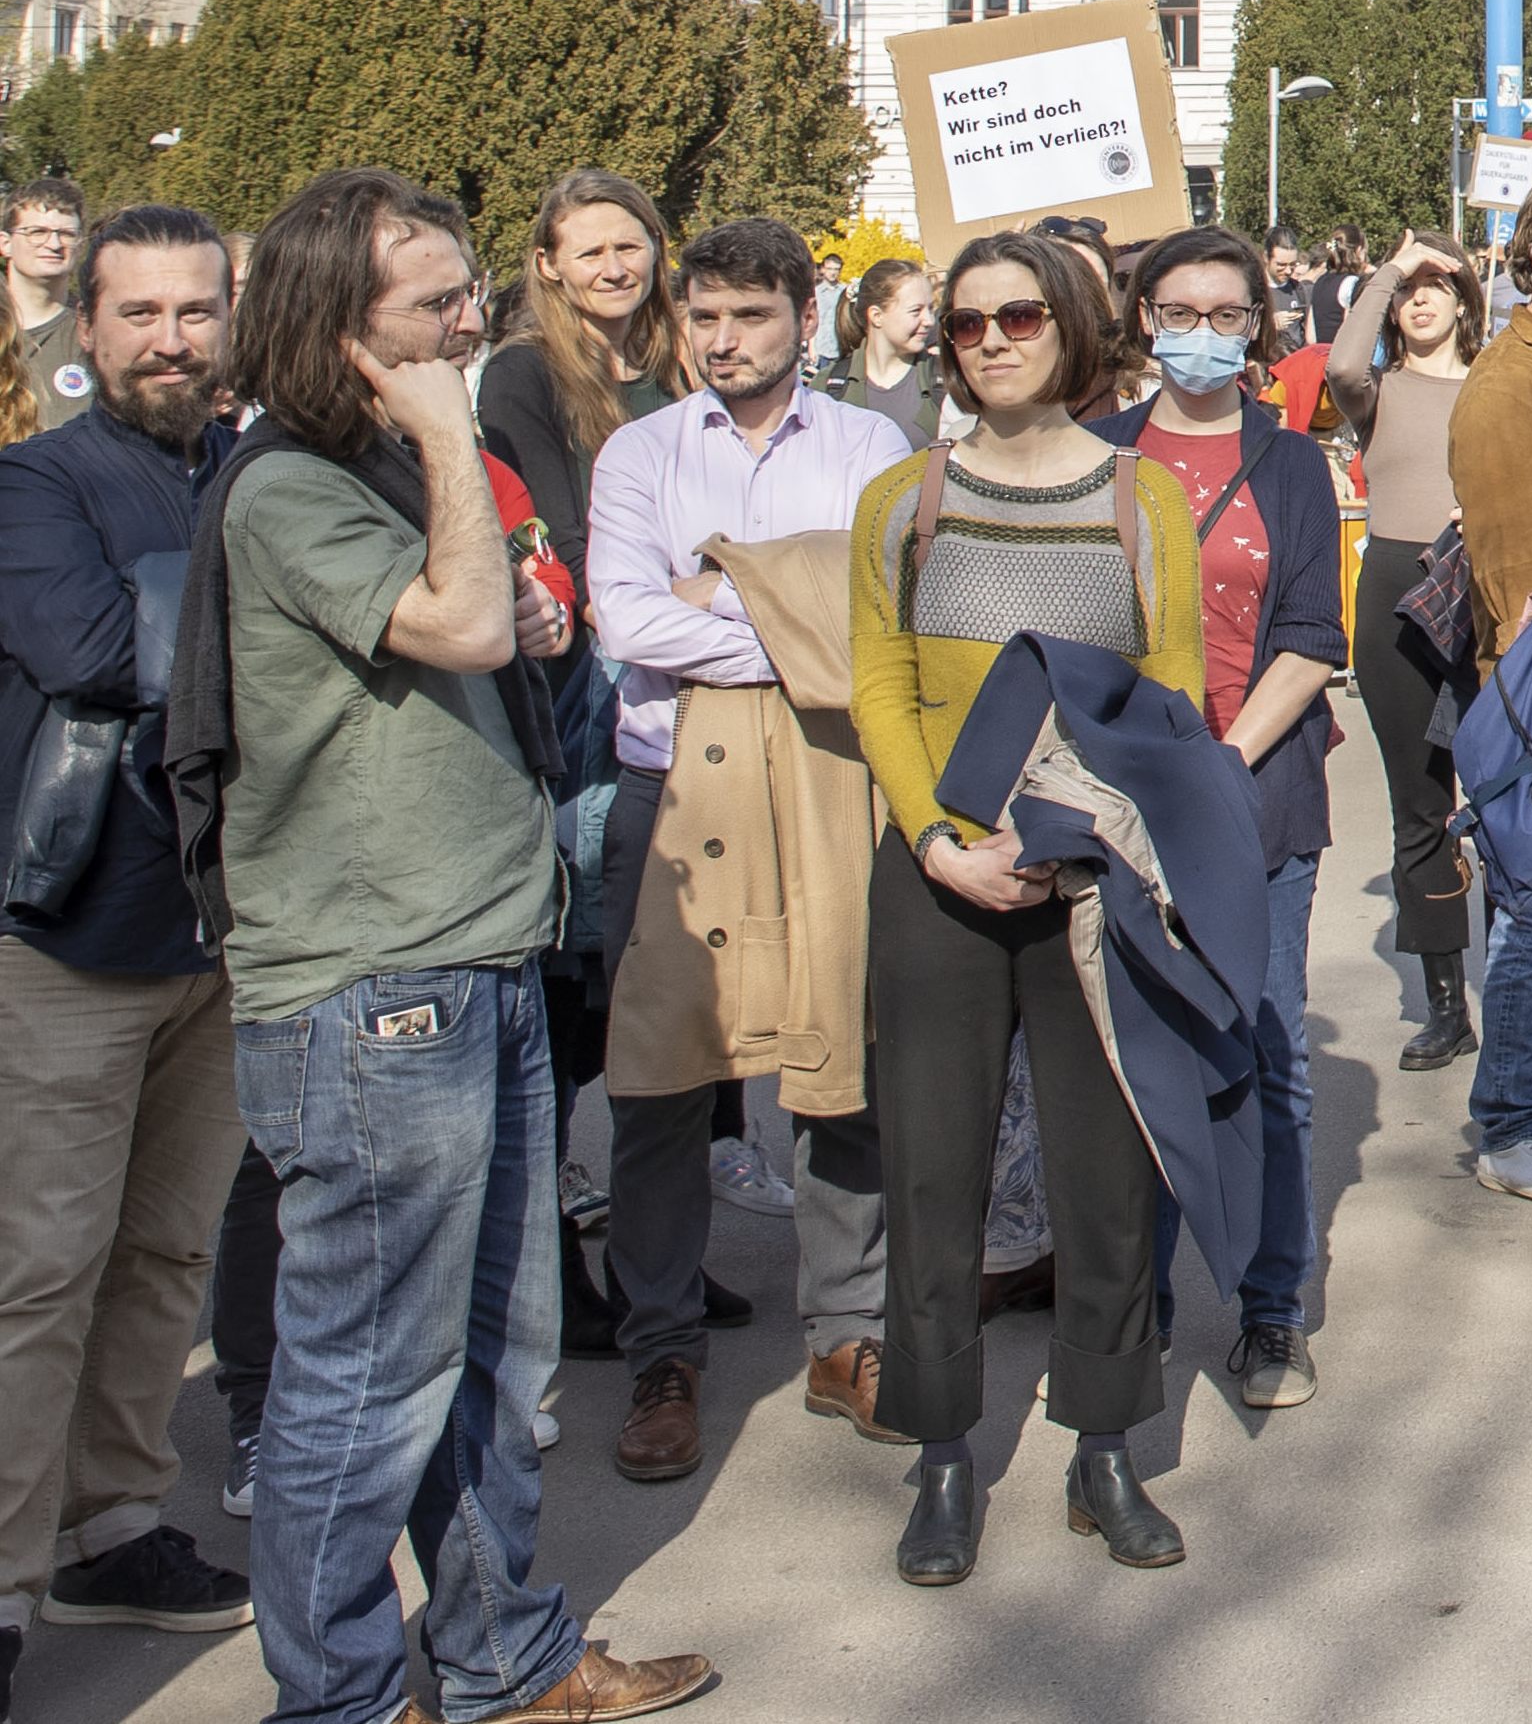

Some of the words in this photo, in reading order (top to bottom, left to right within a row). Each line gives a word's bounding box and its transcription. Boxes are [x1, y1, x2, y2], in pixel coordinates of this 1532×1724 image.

[943, 80, 1009, 107] Kette?
[947, 119, 981, 136] Wir
[986, 108, 1028, 129] sind
[1034, 98, 1082, 120] doch
[953, 143, 1005, 166] nicht
[1010, 140, 1034, 155] im
[1039, 119, 1128, 149] Verließ?!
